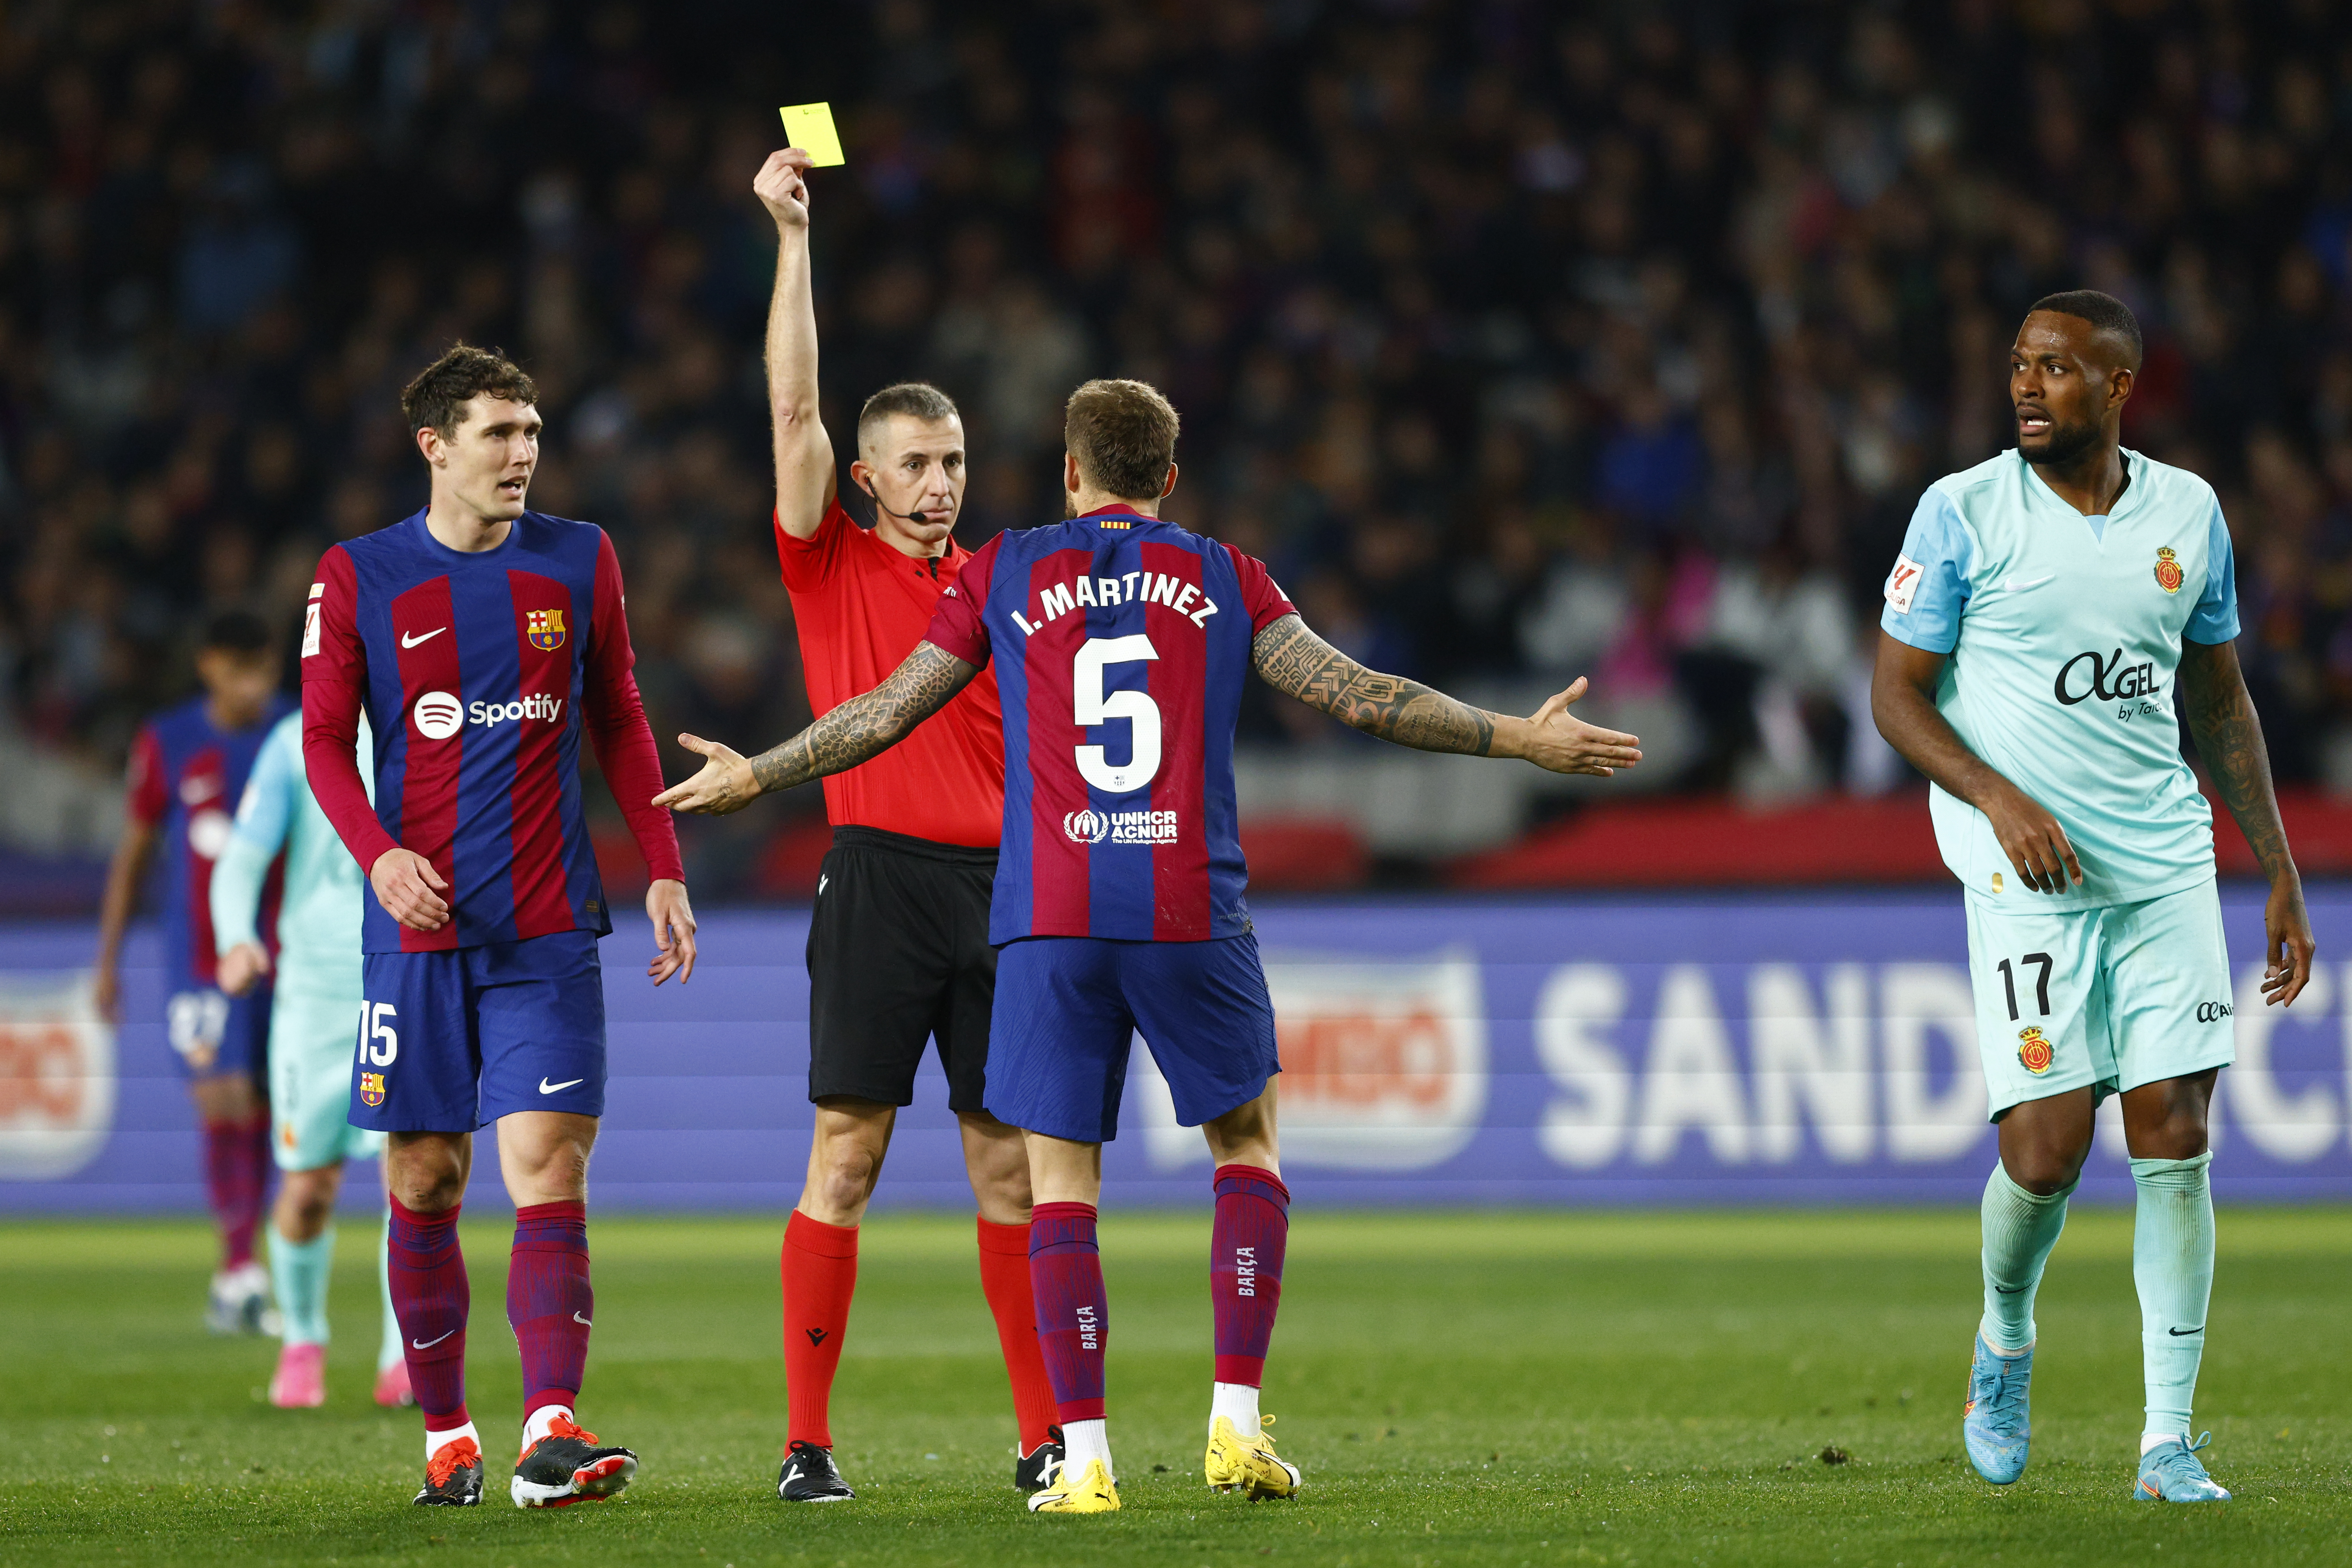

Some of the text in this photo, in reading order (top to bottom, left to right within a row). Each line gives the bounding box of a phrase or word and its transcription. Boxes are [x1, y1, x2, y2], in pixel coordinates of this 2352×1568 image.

[1011, 571, 1218, 636] I. MARTINEZ
[1887, 590, 1905, 606] LALIGA
[304, 640, 316, 651] LIGA
[469, 693, 562, 727] Spotify
[1074, 634, 1161, 793] 5
[2118, 705, 2134, 722] by
[1111, 811, 1177, 826] UNHCR
[1111, 824, 1177, 839] ACNUR
[1997, 952, 2053, 1021] 17
[359, 1000, 397, 1067] 15
[1236, 1247, 1258, 1297] BARÇA
[1076, 1306, 1098, 1349] BARÇA
